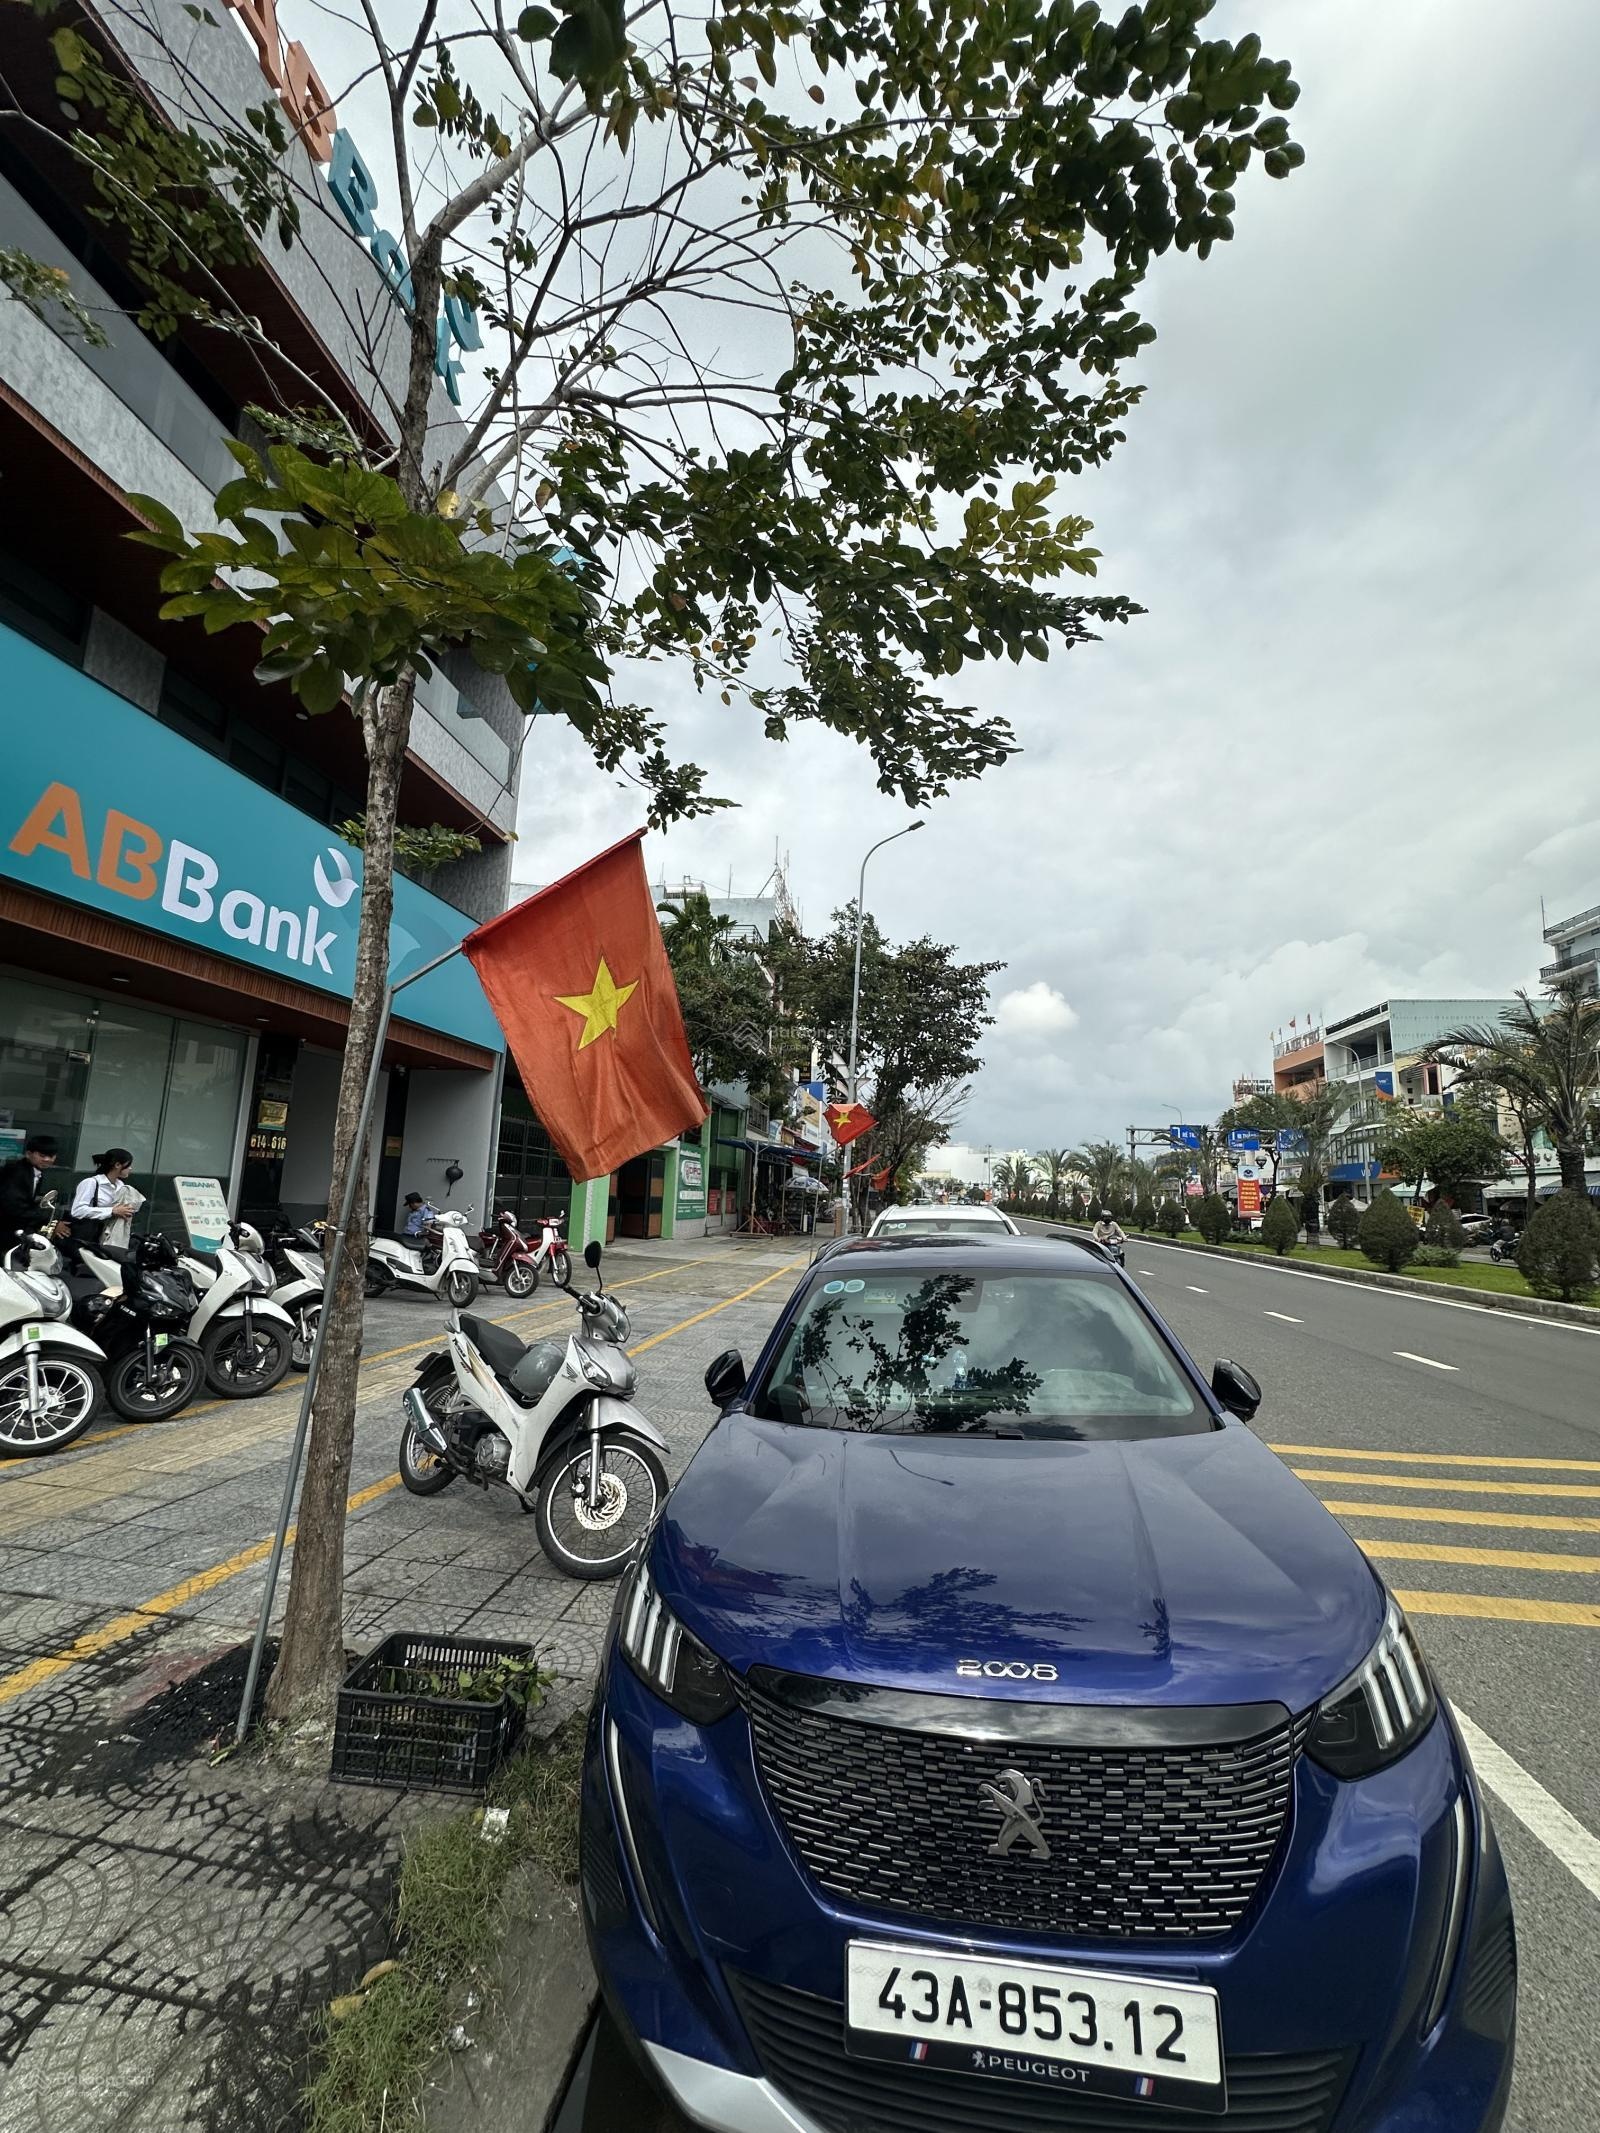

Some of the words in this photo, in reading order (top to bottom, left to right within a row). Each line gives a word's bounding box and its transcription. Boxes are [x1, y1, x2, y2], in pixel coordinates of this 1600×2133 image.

[9, 782, 340, 976] ABBank
[957, 1658, 1059, 1681] 2008
[878, 1967, 1187, 2063] 43A-853.12
[988, 2054, 1090, 2084] PEUGEOT
